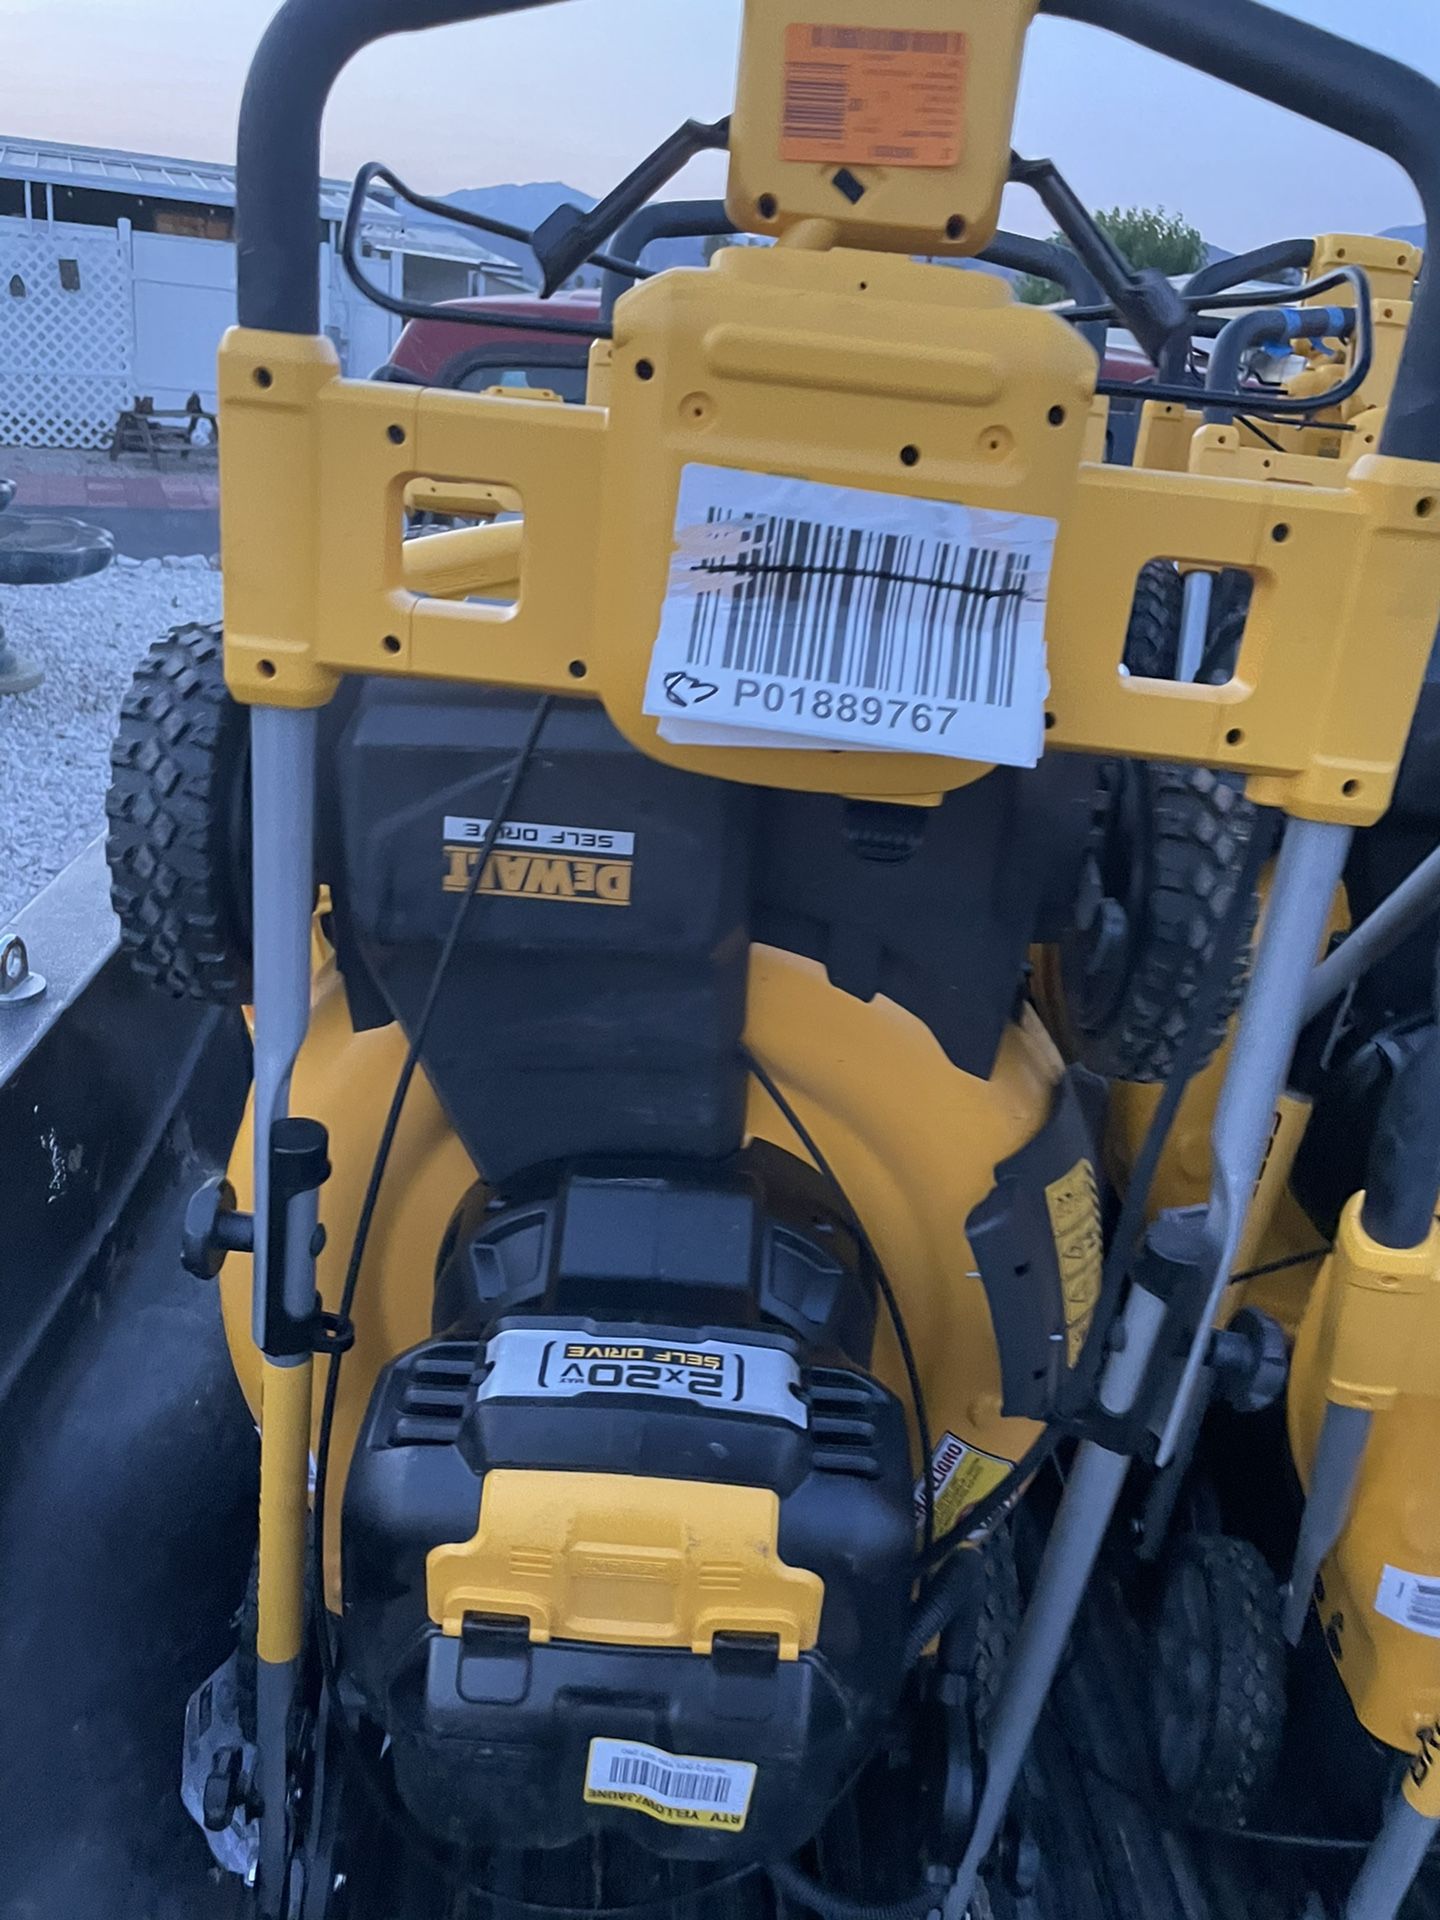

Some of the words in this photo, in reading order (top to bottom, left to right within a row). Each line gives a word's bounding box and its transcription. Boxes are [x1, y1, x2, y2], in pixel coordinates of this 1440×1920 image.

[733, 677, 960, 736] P01889767
[464, 823, 538, 841] DRIE
[551, 831, 614, 848] SELF
[567, 1346, 644, 1359] DRIVE
[654, 1353, 721, 1368] SELF
[710, 1813, 741, 1825] RTV
